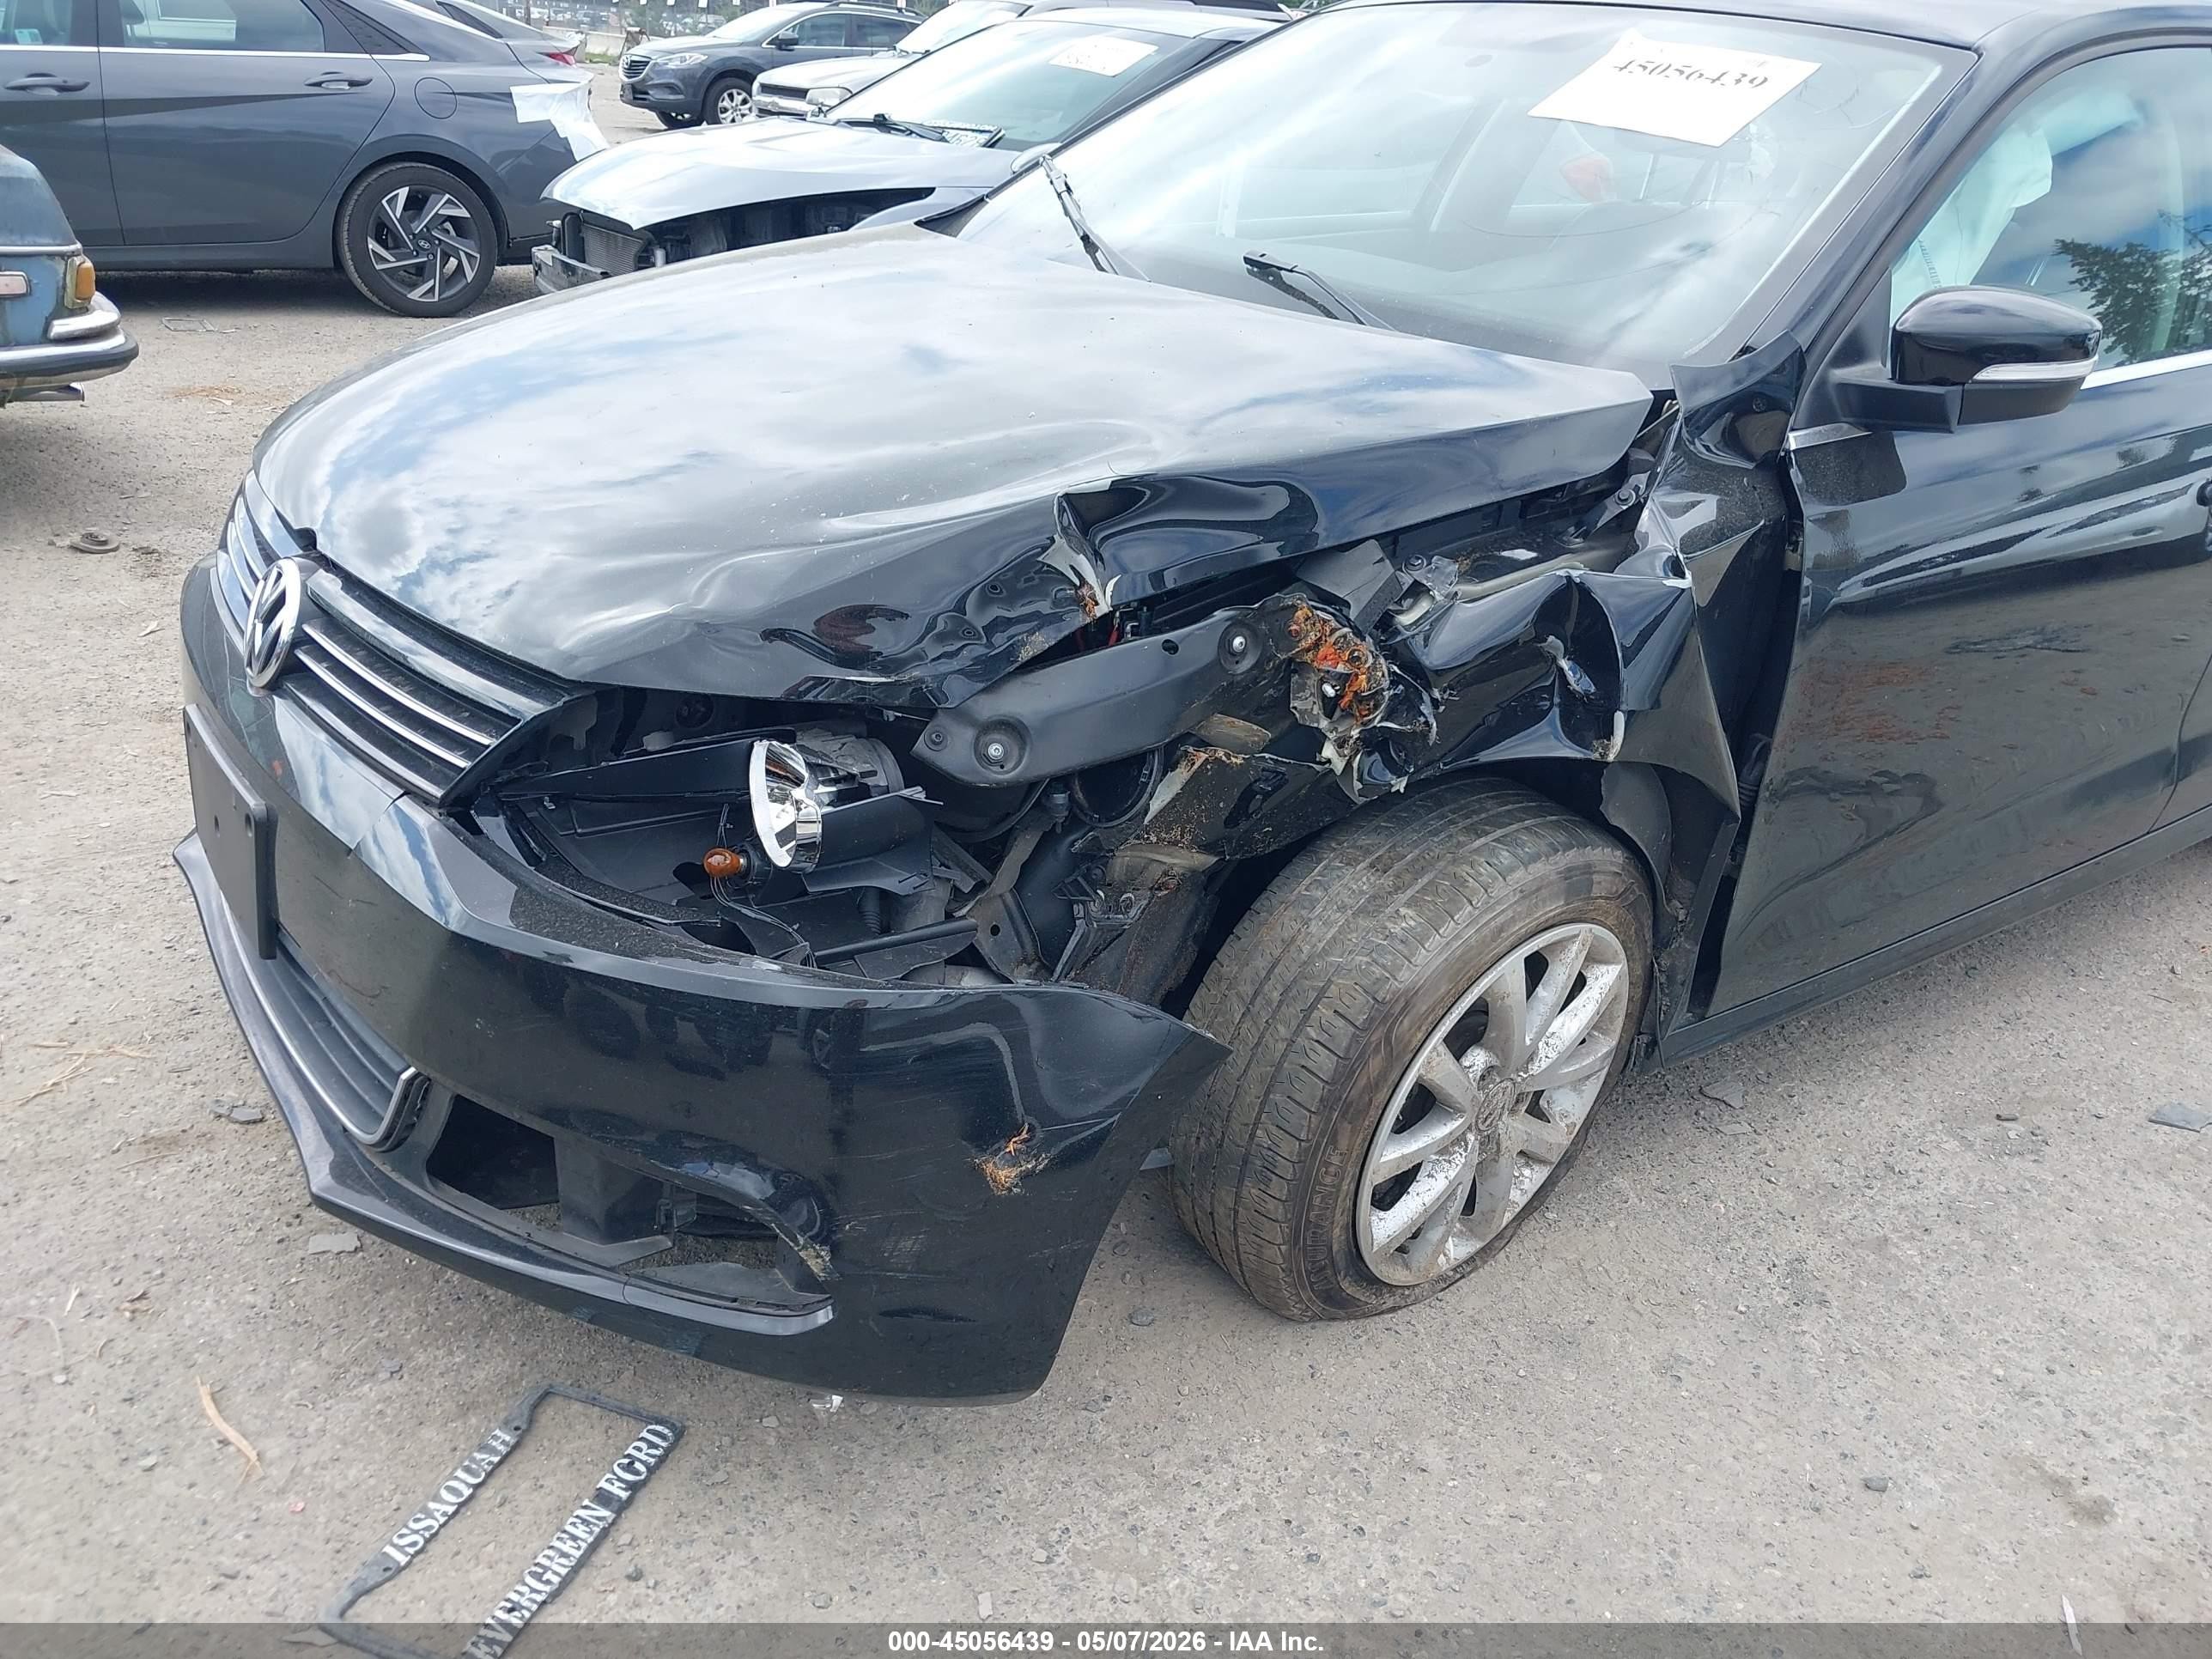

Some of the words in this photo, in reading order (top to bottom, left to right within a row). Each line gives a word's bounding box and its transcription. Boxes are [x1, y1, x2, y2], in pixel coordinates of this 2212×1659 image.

[382, 1429, 515, 1566] ISSAQUAH
[463, 1499, 617, 1659] EVERGREEN
[595, 1425, 675, 1501] FORD
